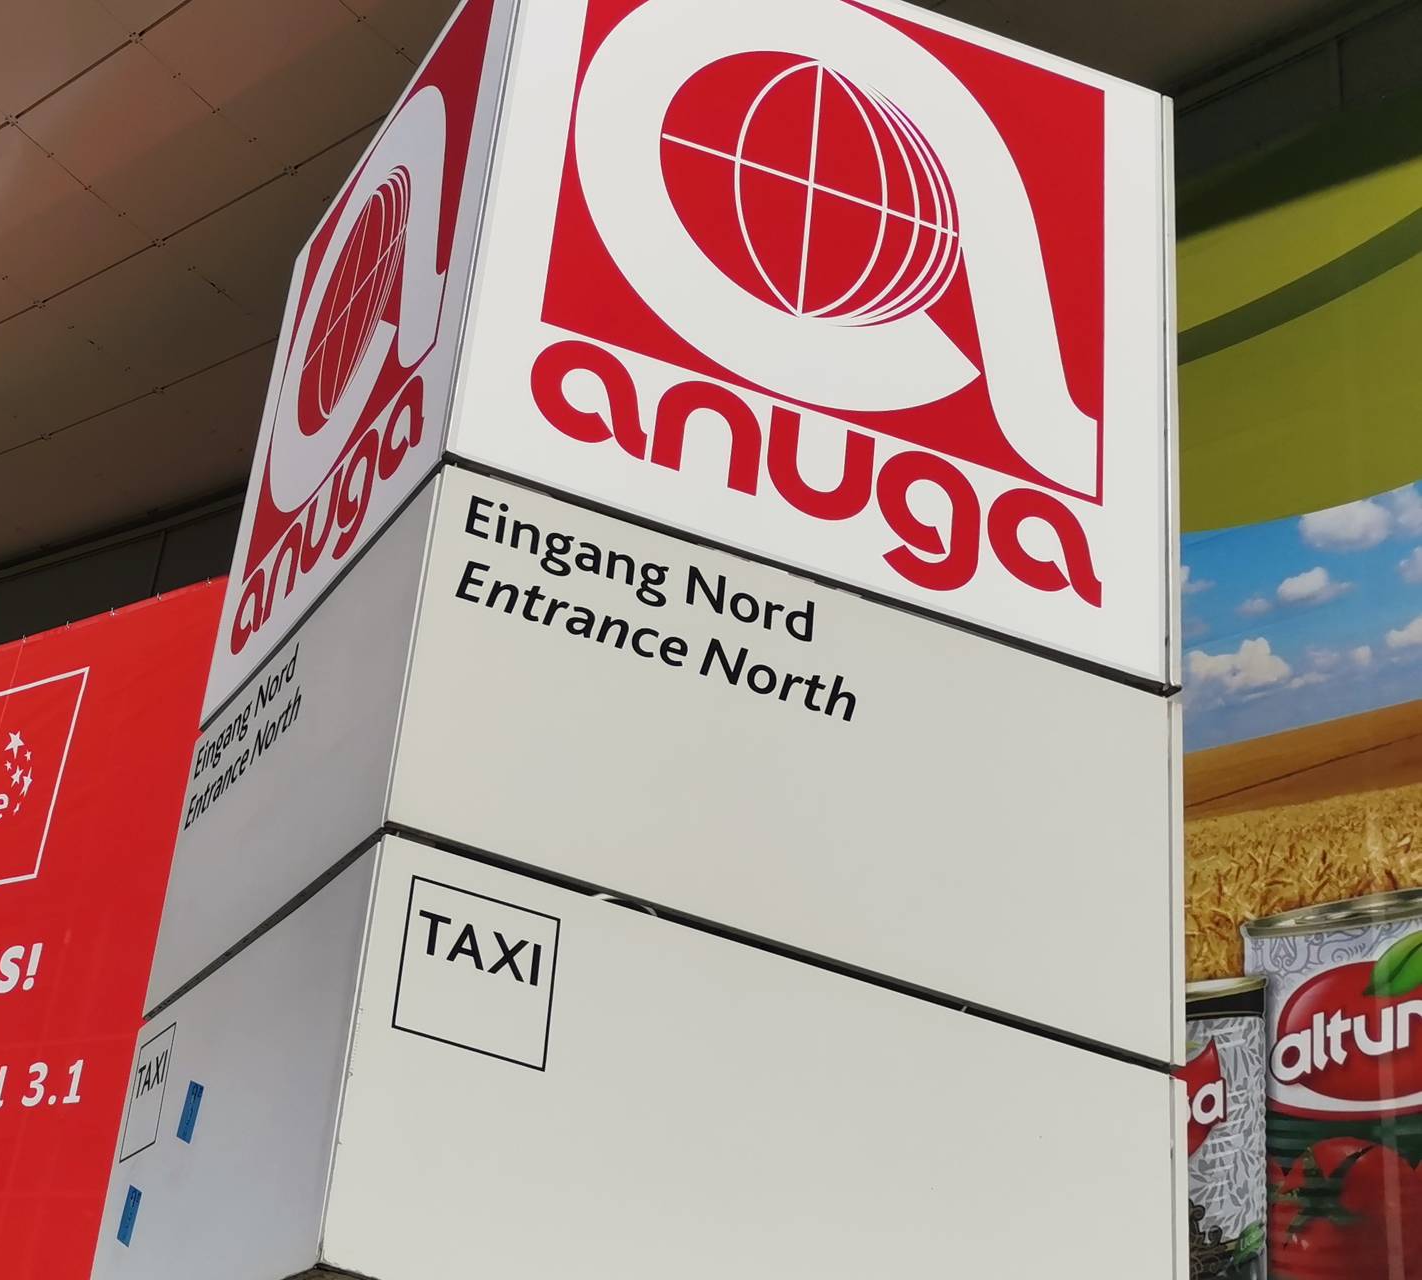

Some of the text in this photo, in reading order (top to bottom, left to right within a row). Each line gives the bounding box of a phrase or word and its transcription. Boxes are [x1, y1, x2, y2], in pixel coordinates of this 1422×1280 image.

[229, 374, 425, 656] anuga
[530, 339, 1102, 609] anuga
[455, 559, 858, 722] Entrance North
[464, 495, 816, 644] Eingang Nord
[183, 686, 302, 831] Entrance North
[193, 642, 300, 780] Eingang Nord
[419, 909, 542, 987] TAXI
[21, 1059, 85, 1108] 3.1
[136, 1048, 169, 1100] TAXI
